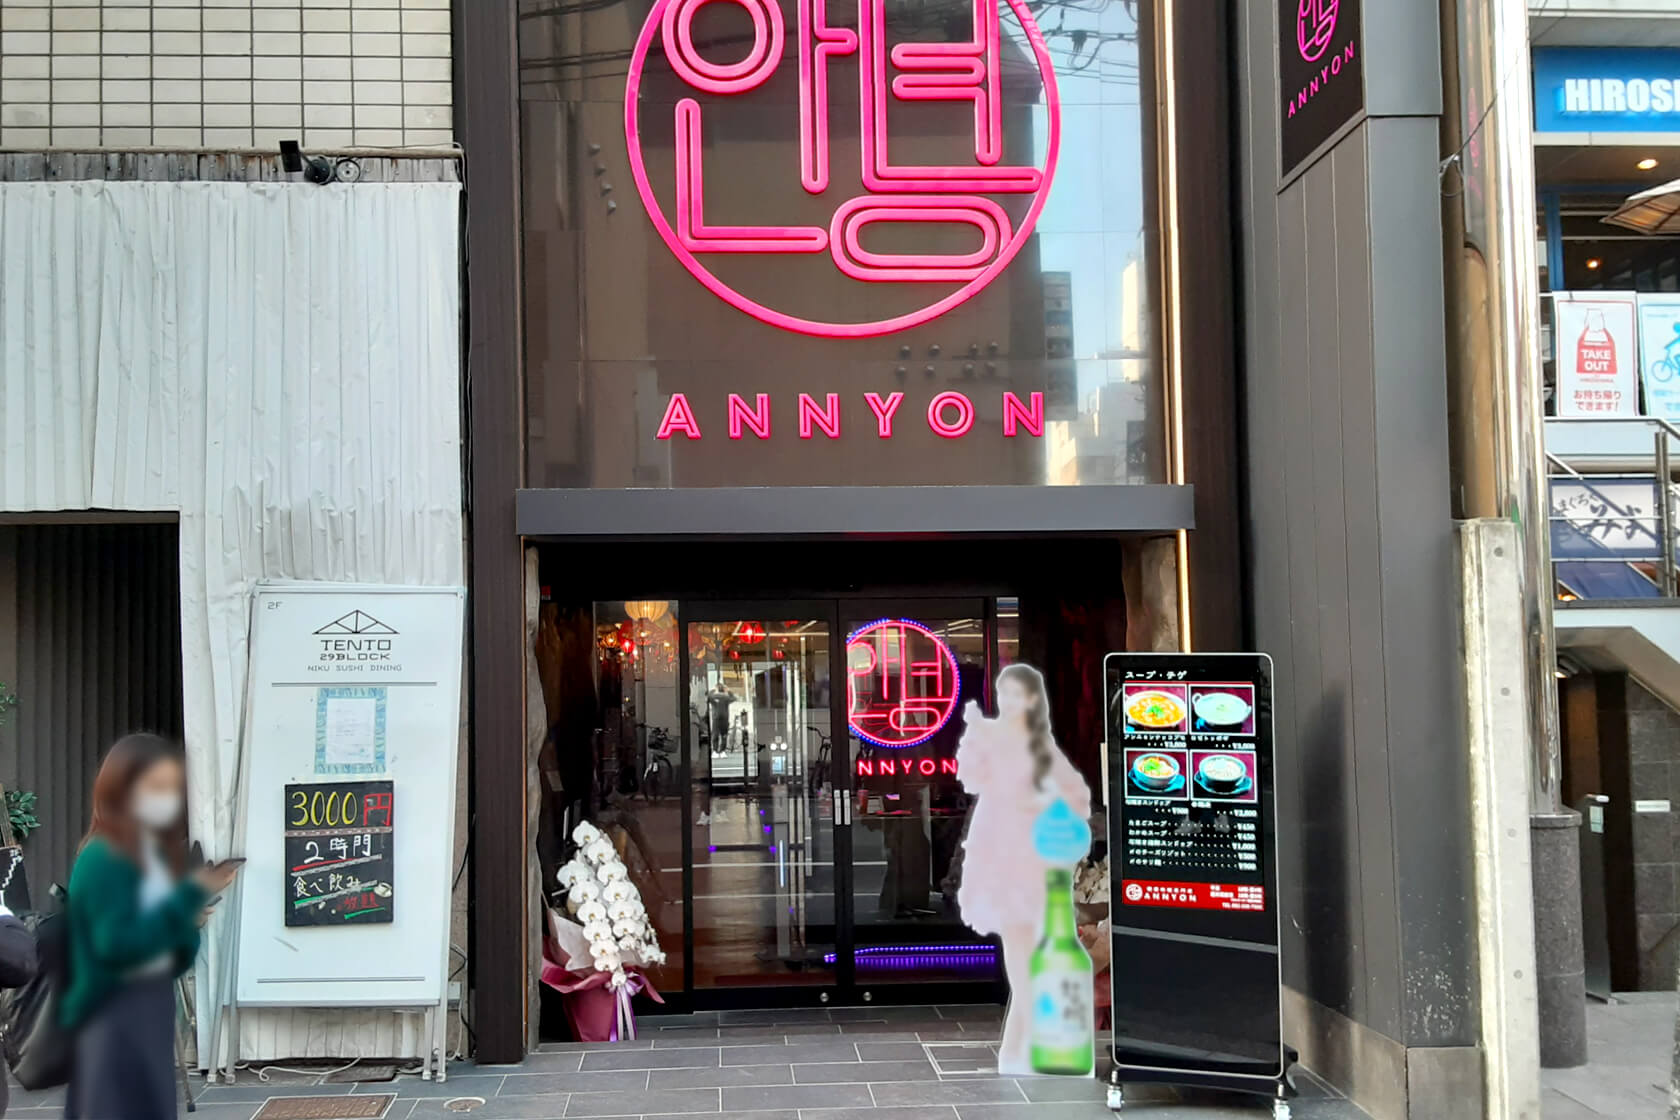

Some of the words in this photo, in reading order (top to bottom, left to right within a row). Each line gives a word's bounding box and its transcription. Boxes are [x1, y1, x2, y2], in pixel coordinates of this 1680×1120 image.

[1287, 40, 1355, 119] ANNYON
[1580, 349, 1611, 360] TAKE
[1584, 360, 1610, 371] OUT
[1573, 389, 1622, 400] お持ち帰り
[656, 391, 1044, 439] ANNYON
[267, 601, 282, 610] 2F
[320, 639, 392, 651] TENTO
[319, 652, 391, 661] 29BLOCK
[307, 664, 331, 672] NIKU
[335, 664, 364, 672] SUSHI
[370, 664, 402, 672] DINING
[857, 758, 957, 775] NNYON
[291, 791, 393, 827] 3000円
[1144, 892, 1197, 902] ANNYON
